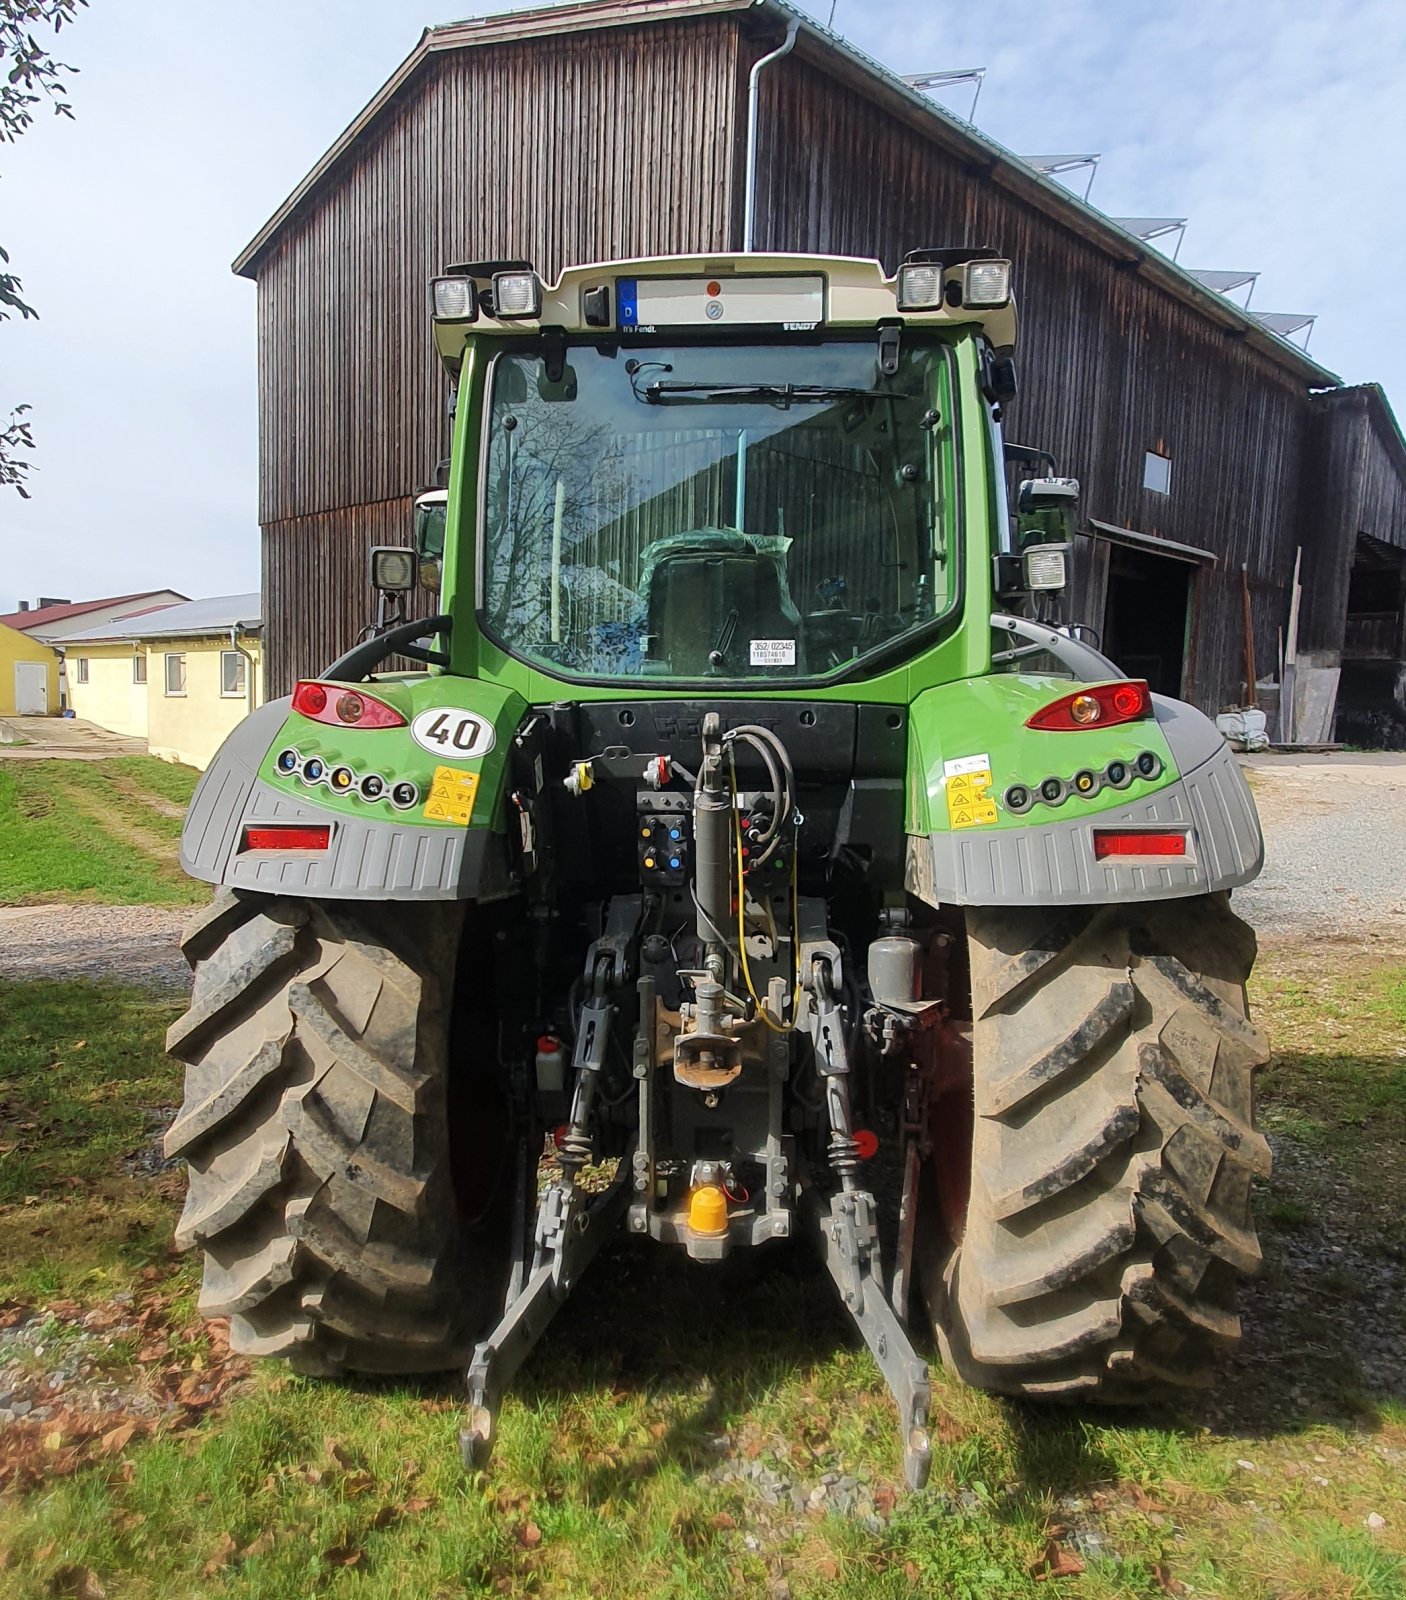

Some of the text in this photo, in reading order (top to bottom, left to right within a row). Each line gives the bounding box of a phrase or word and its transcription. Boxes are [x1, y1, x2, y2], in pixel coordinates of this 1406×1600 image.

[624, 306, 633, 318] D
[783, 322, 818, 331] FENDT
[425, 713, 482, 750] 40
